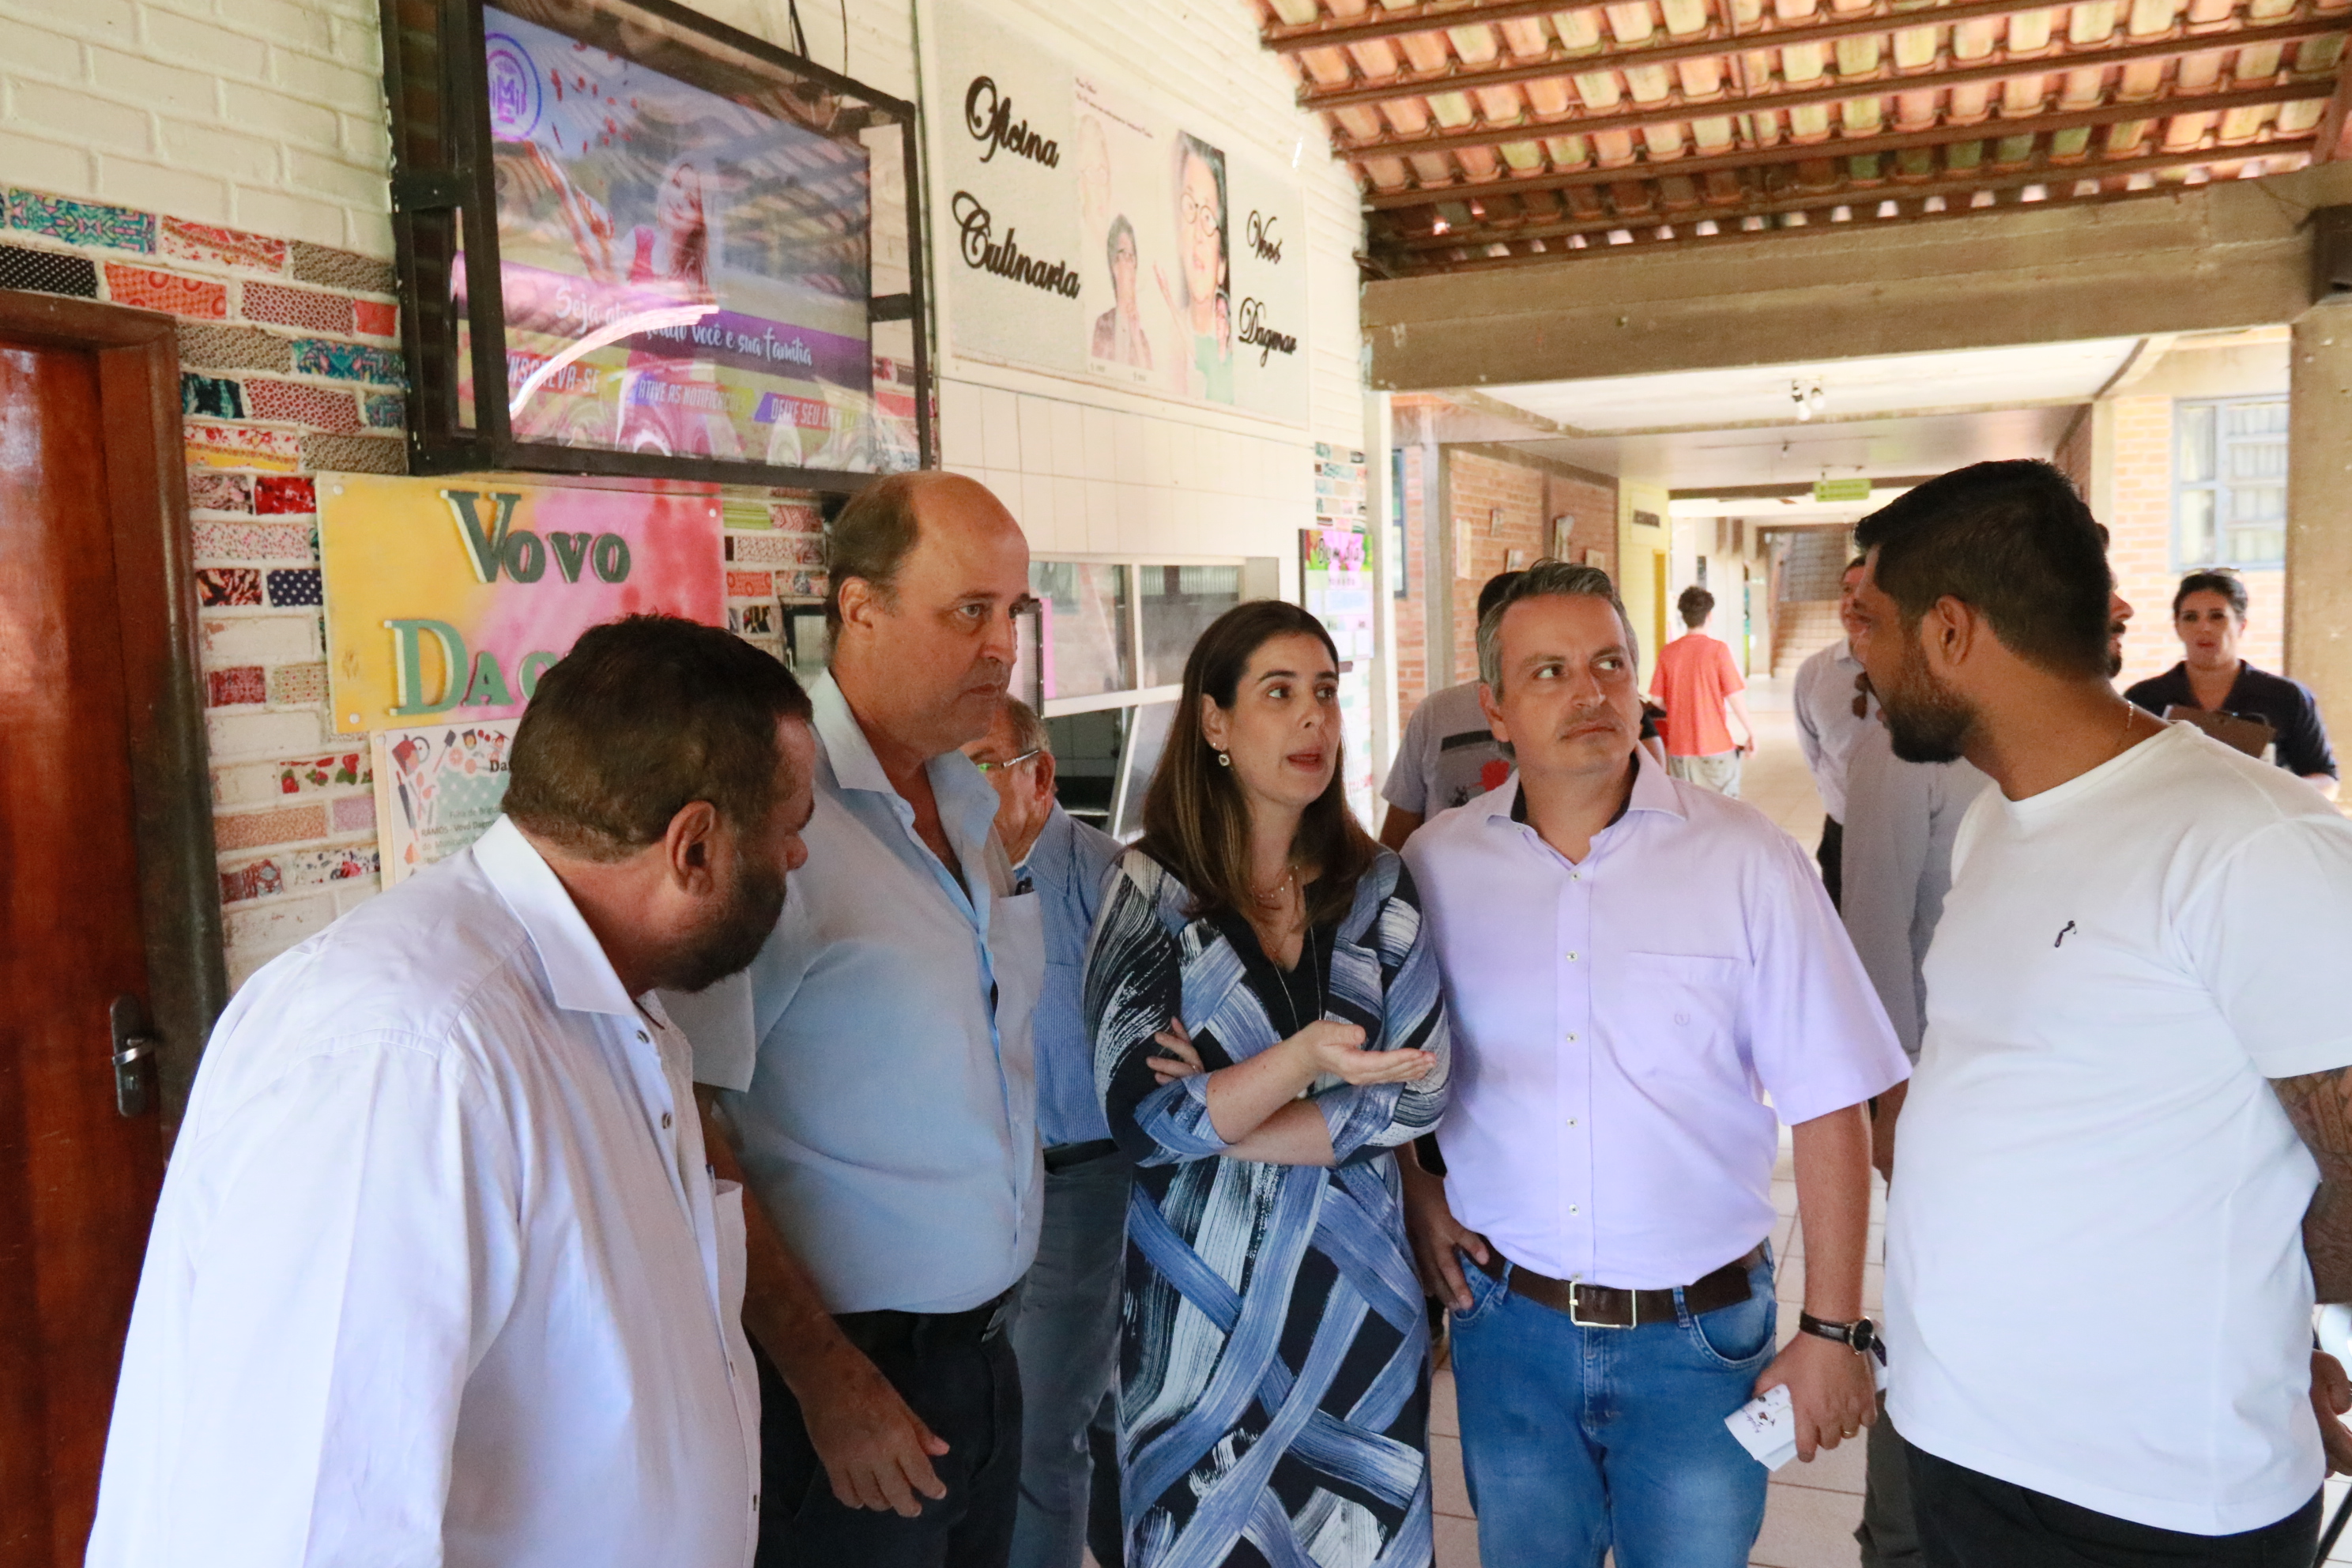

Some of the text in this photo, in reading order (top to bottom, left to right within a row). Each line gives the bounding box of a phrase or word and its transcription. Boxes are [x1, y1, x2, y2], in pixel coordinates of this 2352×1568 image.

[965, 75, 1060, 169] Oficina
[556, 283, 600, 334] Seja
[690, 323, 722, 346] você
[726, 331, 736, 349] e
[737, 334, 762, 356] sua
[1238, 297, 1297, 368] Dagmar
[669, 384, 682, 404] AS
[801, 403, 820, 426] SEU
[421, 827, 449, 837] RAMOS
